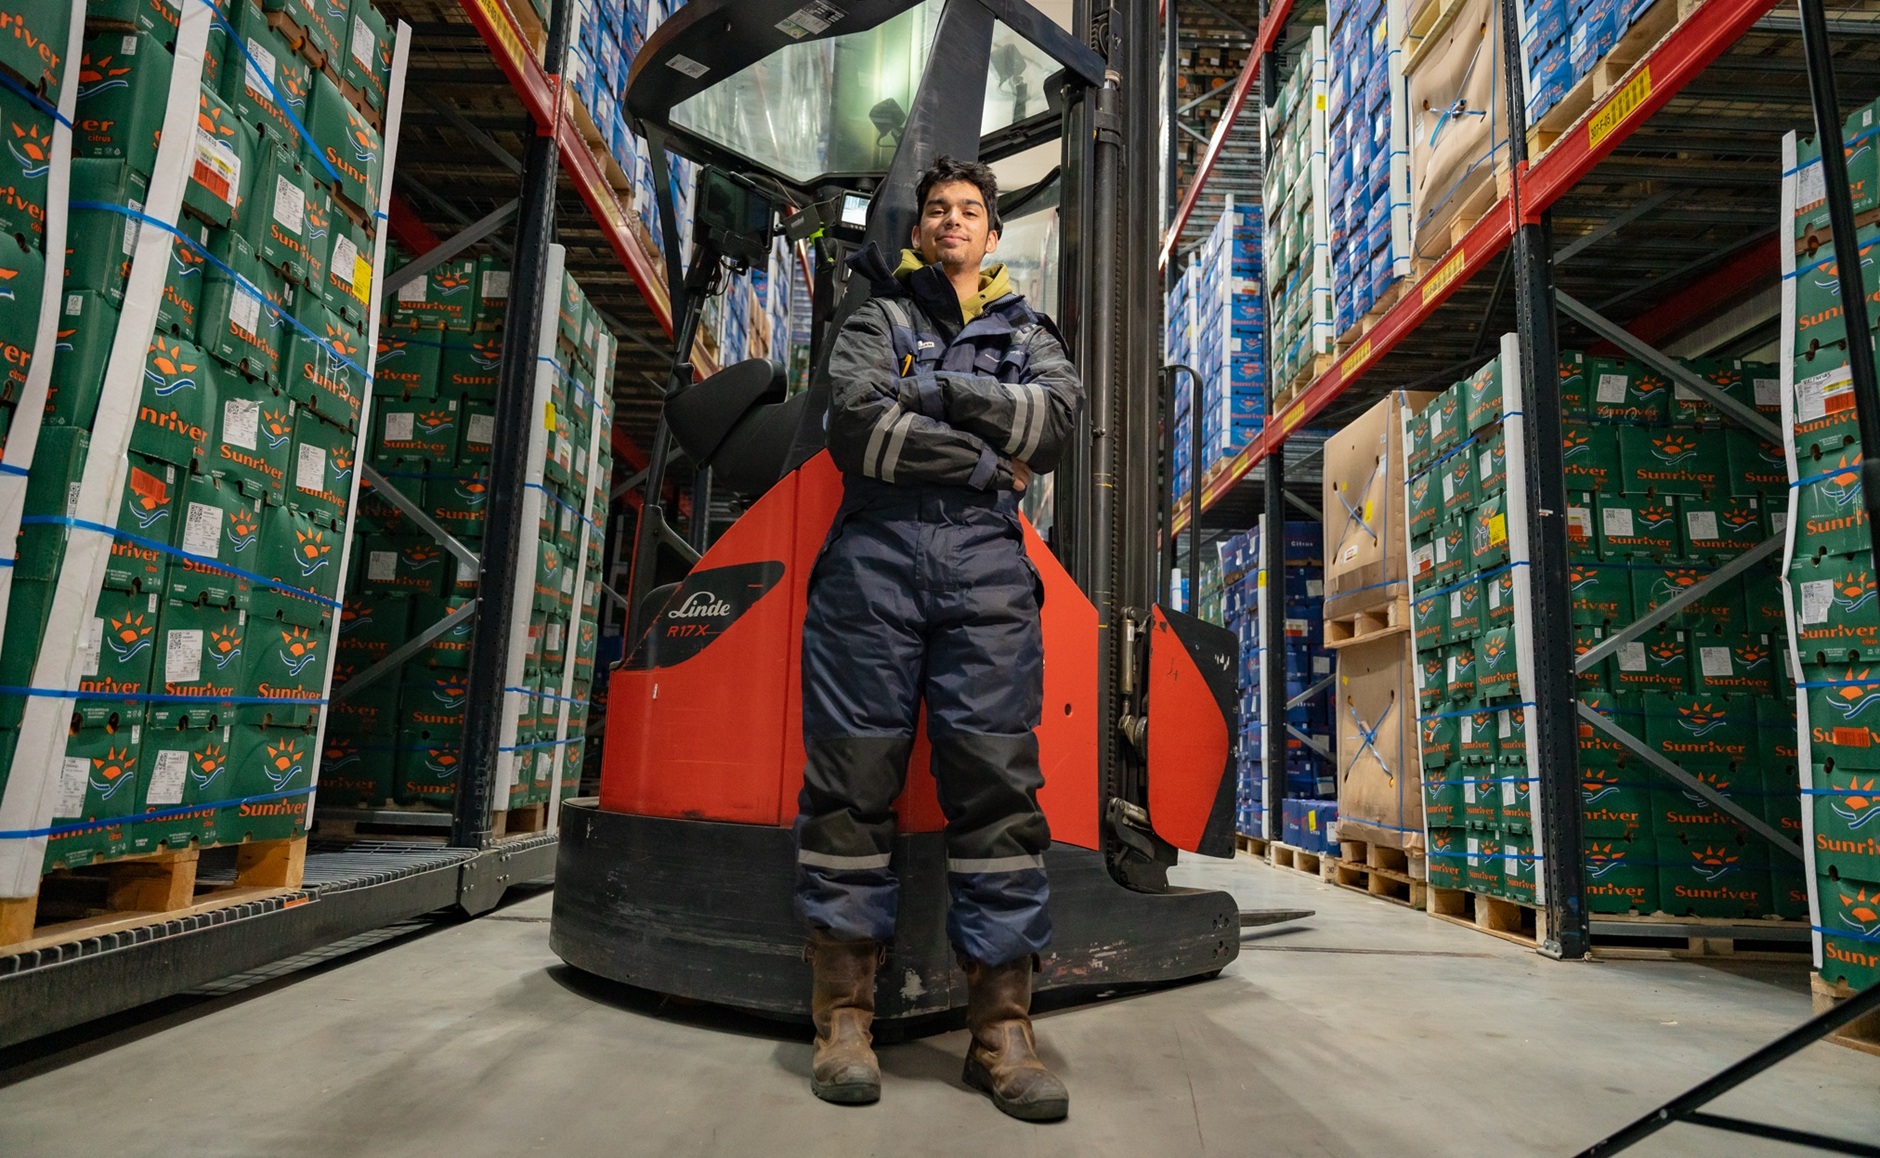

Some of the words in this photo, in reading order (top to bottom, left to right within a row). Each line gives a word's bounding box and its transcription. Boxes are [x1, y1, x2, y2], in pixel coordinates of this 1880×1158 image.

[0, 11, 60, 69] river
[245, 84, 300, 140] Sunriver
[88, 134, 113, 142] citrus
[0, 186, 45, 222] iver
[271, 223, 322, 270] Sunriver
[162, 285, 195, 315] river
[399, 301, 463, 312] Sunriver
[229, 321, 279, 363] Sunriver
[376, 369, 421, 382] river
[453, 374, 499, 385] Sunri
[303, 363, 361, 410] Sunriver
[140, 406, 208, 443] nriver
[1794, 410, 1857, 436] Sunrive
[383, 440, 447, 450] Sunriver
[220, 445, 283, 480] Sunriver
[1564, 464, 1608, 476] river
[1637, 468, 1715, 482] Sunriver
[1745, 472, 1788, 482] Sunr
[296, 486, 346, 508] Sunriver
[435, 508, 486, 521] Sunri
[1806, 509, 1869, 536] Sunri
[1608, 535, 1671, 547] Sunriver
[111, 541, 160, 562] nriver
[668, 591, 730, 618] Linde
[1573, 598, 1618, 611] river
[1490, 605, 1514, 619] Sunrive
[666, 624, 710, 637] R17X
[1800, 624, 1878, 641] Sunriver
[337, 638, 388, 650] nriver
[81, 676, 141, 694] nriver
[1478, 672, 1517, 685] Sunriver
[1620, 673, 1682, 684] Sunriver
[1704, 675, 1769, 687] Sunriver
[165, 682, 233, 697] Sunriver
[258, 682, 321, 699] Sunriver
[413, 712, 464, 724] Sunri
[1500, 740, 1526, 749] Sunrive
[1579, 737, 1622, 750] nrive
[1662, 740, 1745, 753] Sunriver
[407, 782, 456, 794] Sunri
[239, 798, 307, 817] Sunriver
[1503, 808, 1531, 817] Sunrive
[1583, 808, 1639, 822] nriver
[1667, 811, 1738, 825] Sunriv
[1817, 833, 1880, 857] Sunri
[1507, 876, 1535, 890] Sunrive
[1586, 883, 1645, 897] nriver
[1675, 885, 1758, 900] Sunriver
[1826, 941, 1880, 969] Sunr
